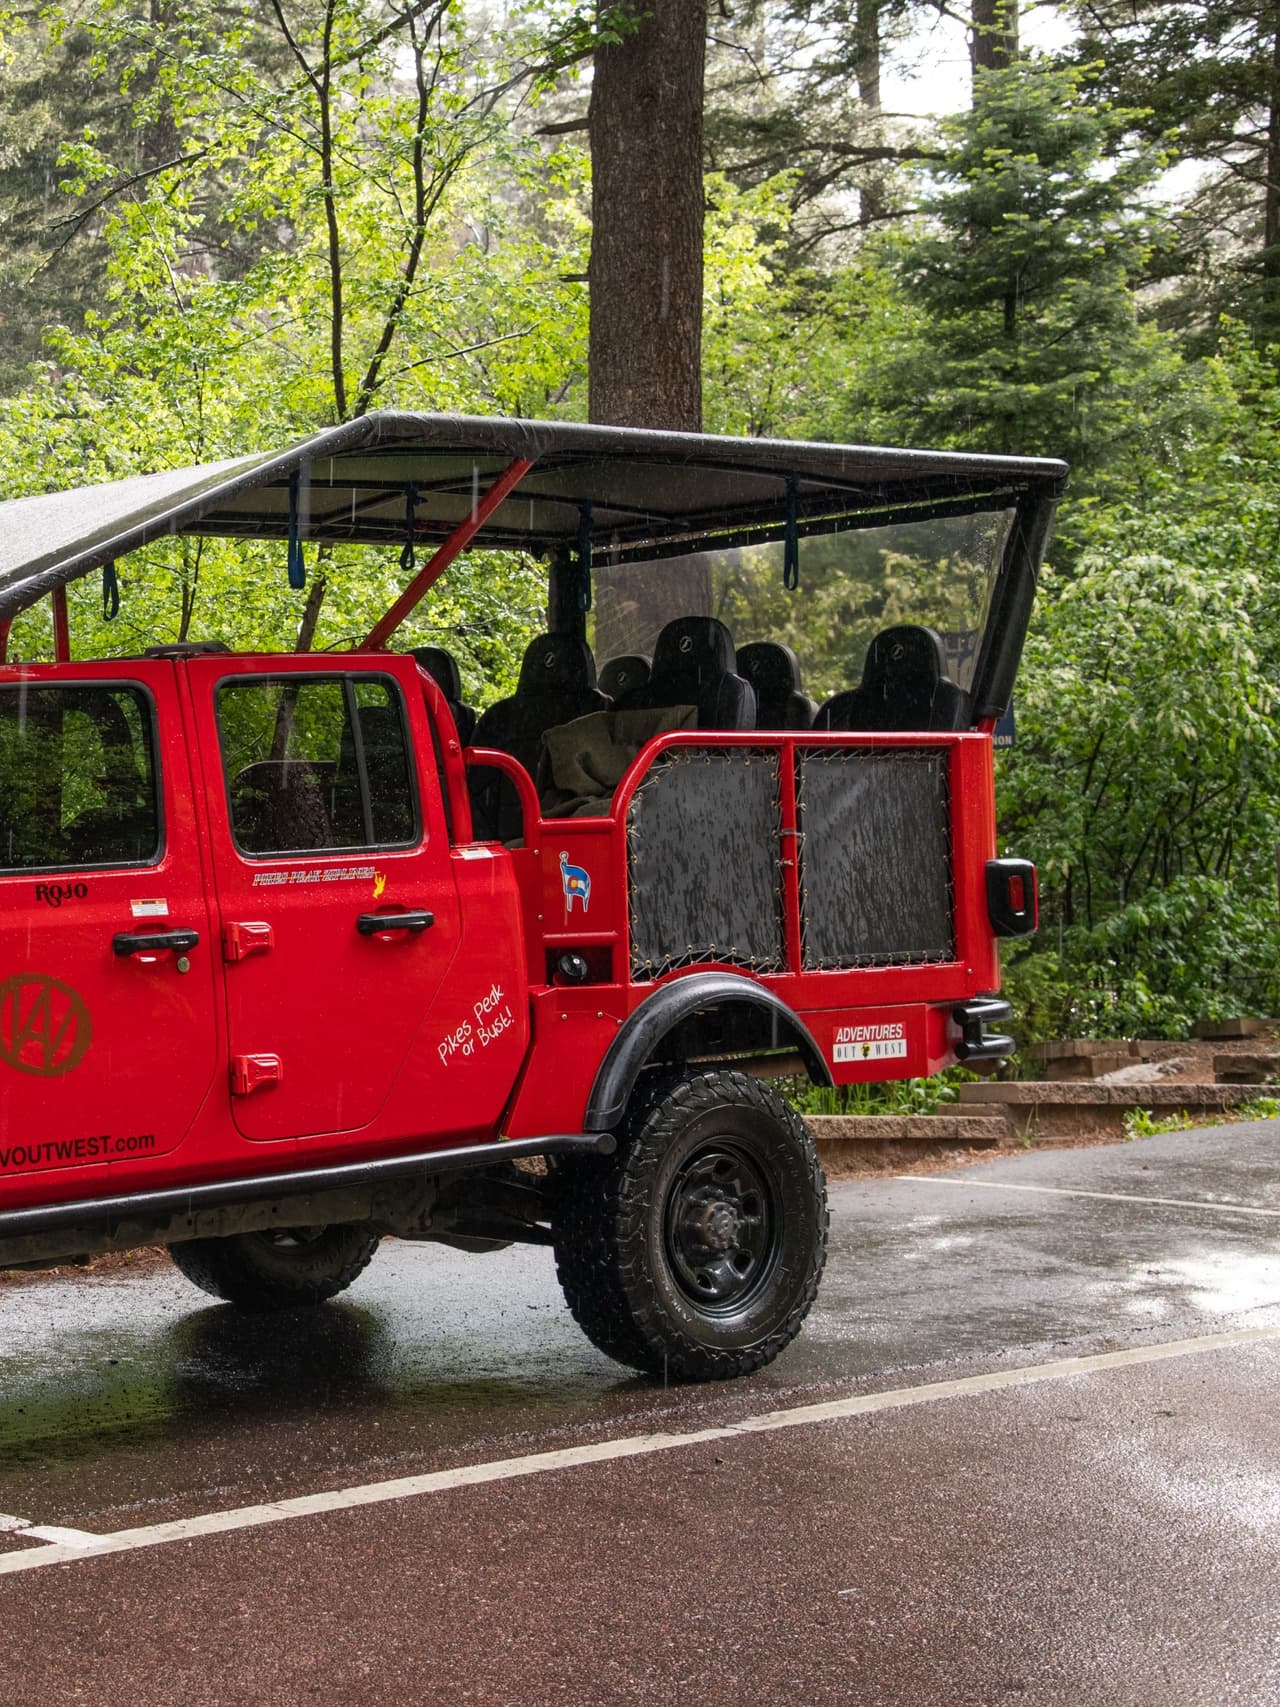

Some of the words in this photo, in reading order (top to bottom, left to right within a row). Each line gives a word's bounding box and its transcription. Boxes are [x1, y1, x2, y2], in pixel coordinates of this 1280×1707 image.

[289, 869, 322, 883] PEAK
[35, 882, 88, 908] ROJO
[437, 1019, 472, 1067] Pikes
[473, 983, 504, 1026] Peak
[462, 1038, 475, 1056] or
[477, 1005, 515, 1047] Bust!
[835, 1023, 903, 1043] ADVENTURES
[837, 1046, 856, 1059] OUT
[875, 1042, 902, 1056] WEST
